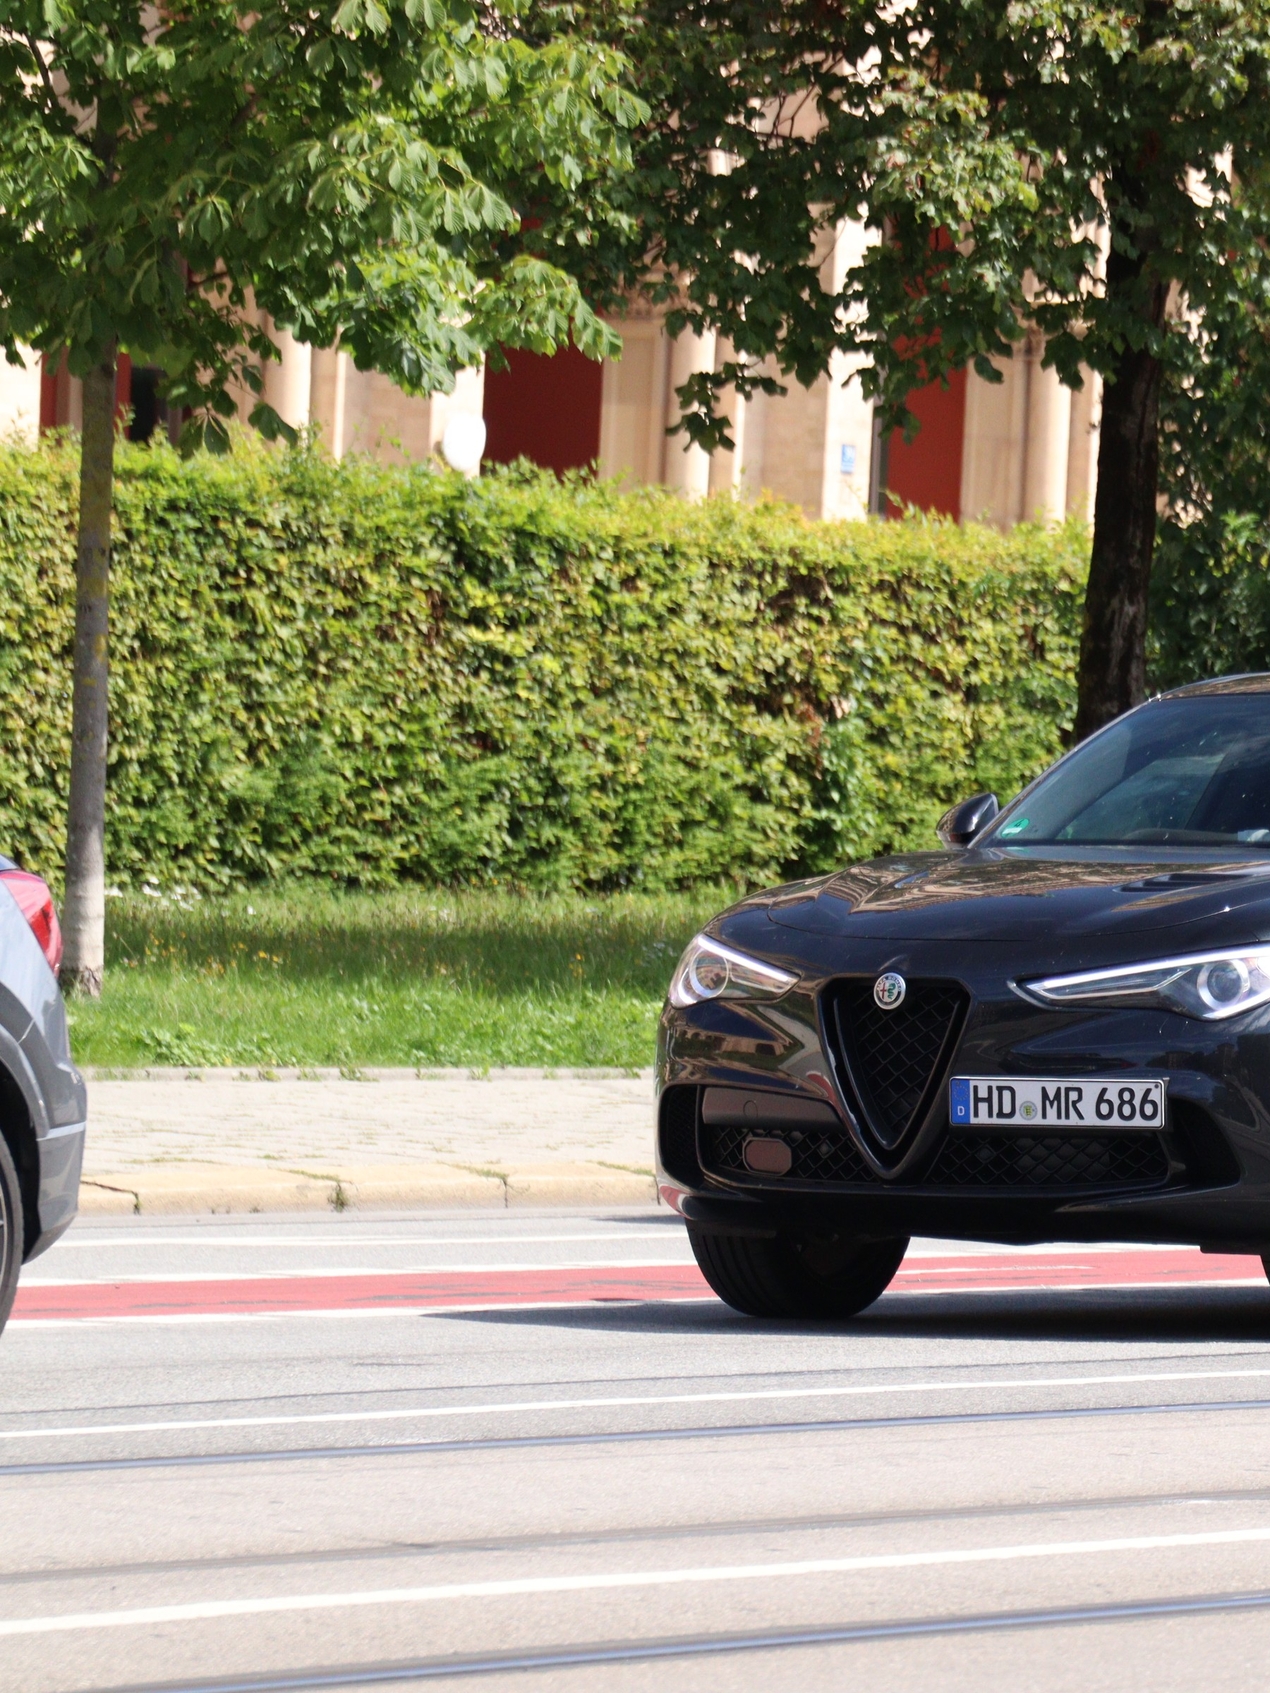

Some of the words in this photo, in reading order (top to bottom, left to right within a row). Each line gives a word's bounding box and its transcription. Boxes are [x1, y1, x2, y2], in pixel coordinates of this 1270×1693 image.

[973, 1085, 1016, 1120] HD
[1041, 1086, 1085, 1121] MR
[1095, 1087, 1159, 1122] 686
